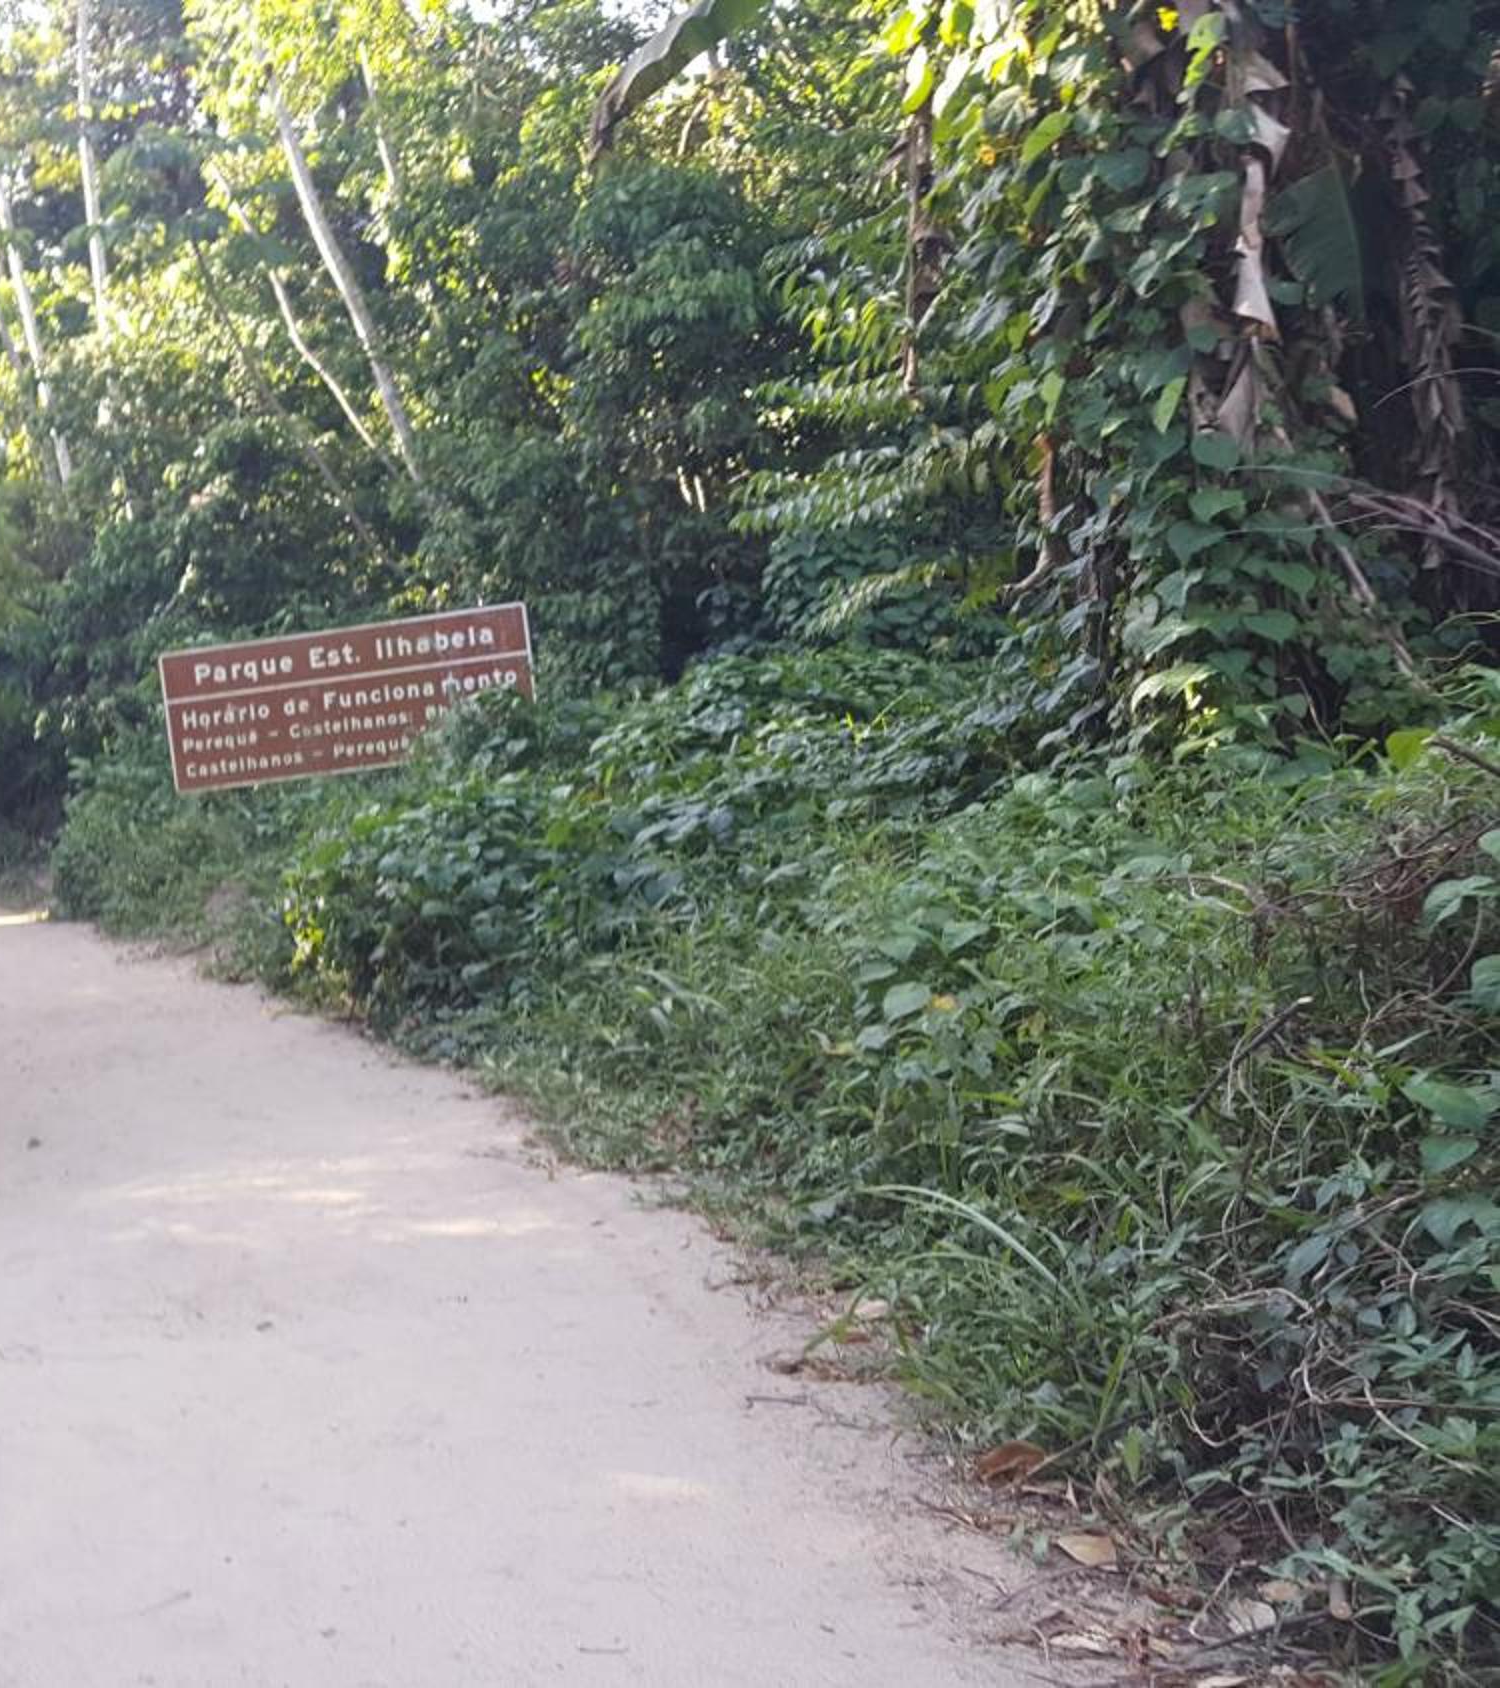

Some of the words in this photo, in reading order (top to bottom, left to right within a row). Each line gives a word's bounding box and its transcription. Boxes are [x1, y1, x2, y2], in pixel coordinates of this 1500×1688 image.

[194, 656, 293, 685] Parque
[308, 643, 361, 669] Est.
[375, 626, 494, 659] Ilhabela
[181, 703, 270, 731] Horário
[283, 698, 310, 716] de
[186, 752, 303, 778] Castelhanos
